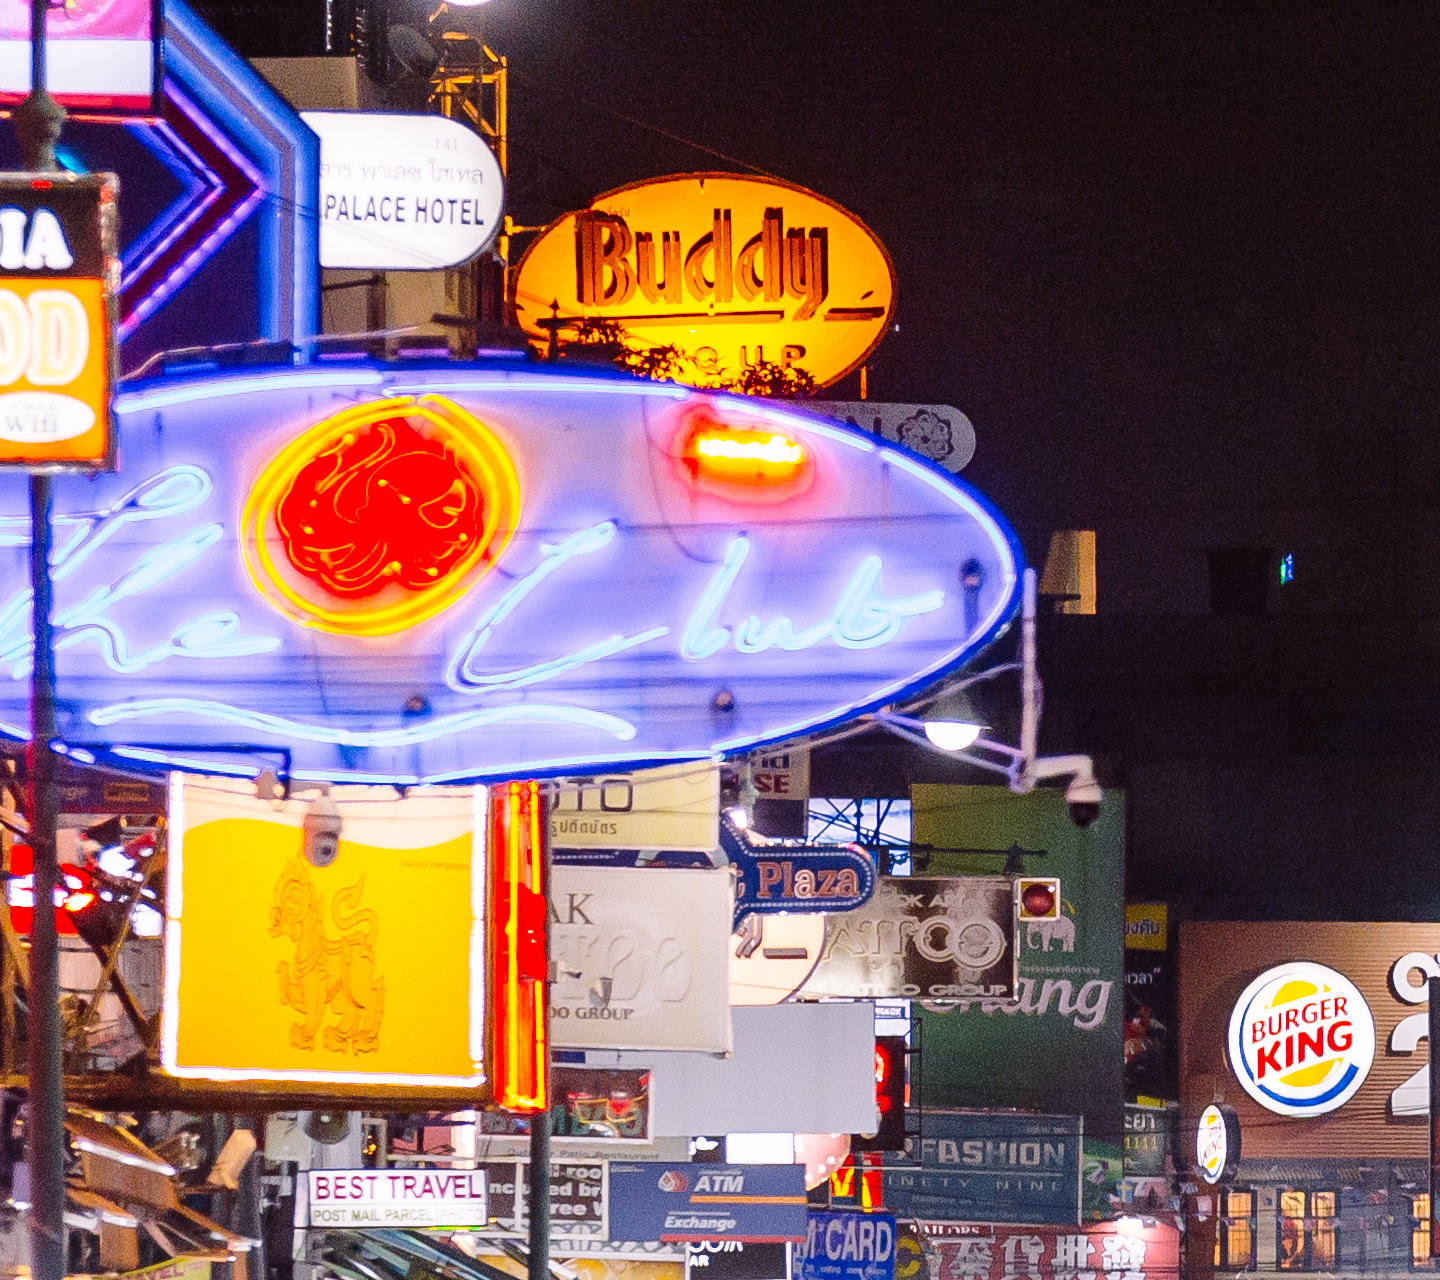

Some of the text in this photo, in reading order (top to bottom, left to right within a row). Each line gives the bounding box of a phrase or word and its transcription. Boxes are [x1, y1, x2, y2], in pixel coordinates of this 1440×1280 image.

[327, 195, 485, 226] PALACE HOTEL
[574, 207, 829, 321] Buddy
[757, 862, 859, 899] Plaza
[928, 983, 1007, 997] GROUP
[575, 1007, 635, 1021] GROUP
[1251, 996, 1348, 1045] BURGER
[1256, 1020, 1354, 1080] KING
[921, 1139, 1066, 1166] FASHION
[316, 1174, 483, 1201] BEST TRAVEL
[694, 1175, 745, 1193] ATM
[888, 1176, 973, 1187] INETY
[313, 1207, 349, 1222] POST
[350, 1207, 381, 1222] MAIL
[384, 1206, 433, 1222] PARCEL
[664, 1215, 738, 1233] Exchange
[825, 1219, 894, 1263] CARD
